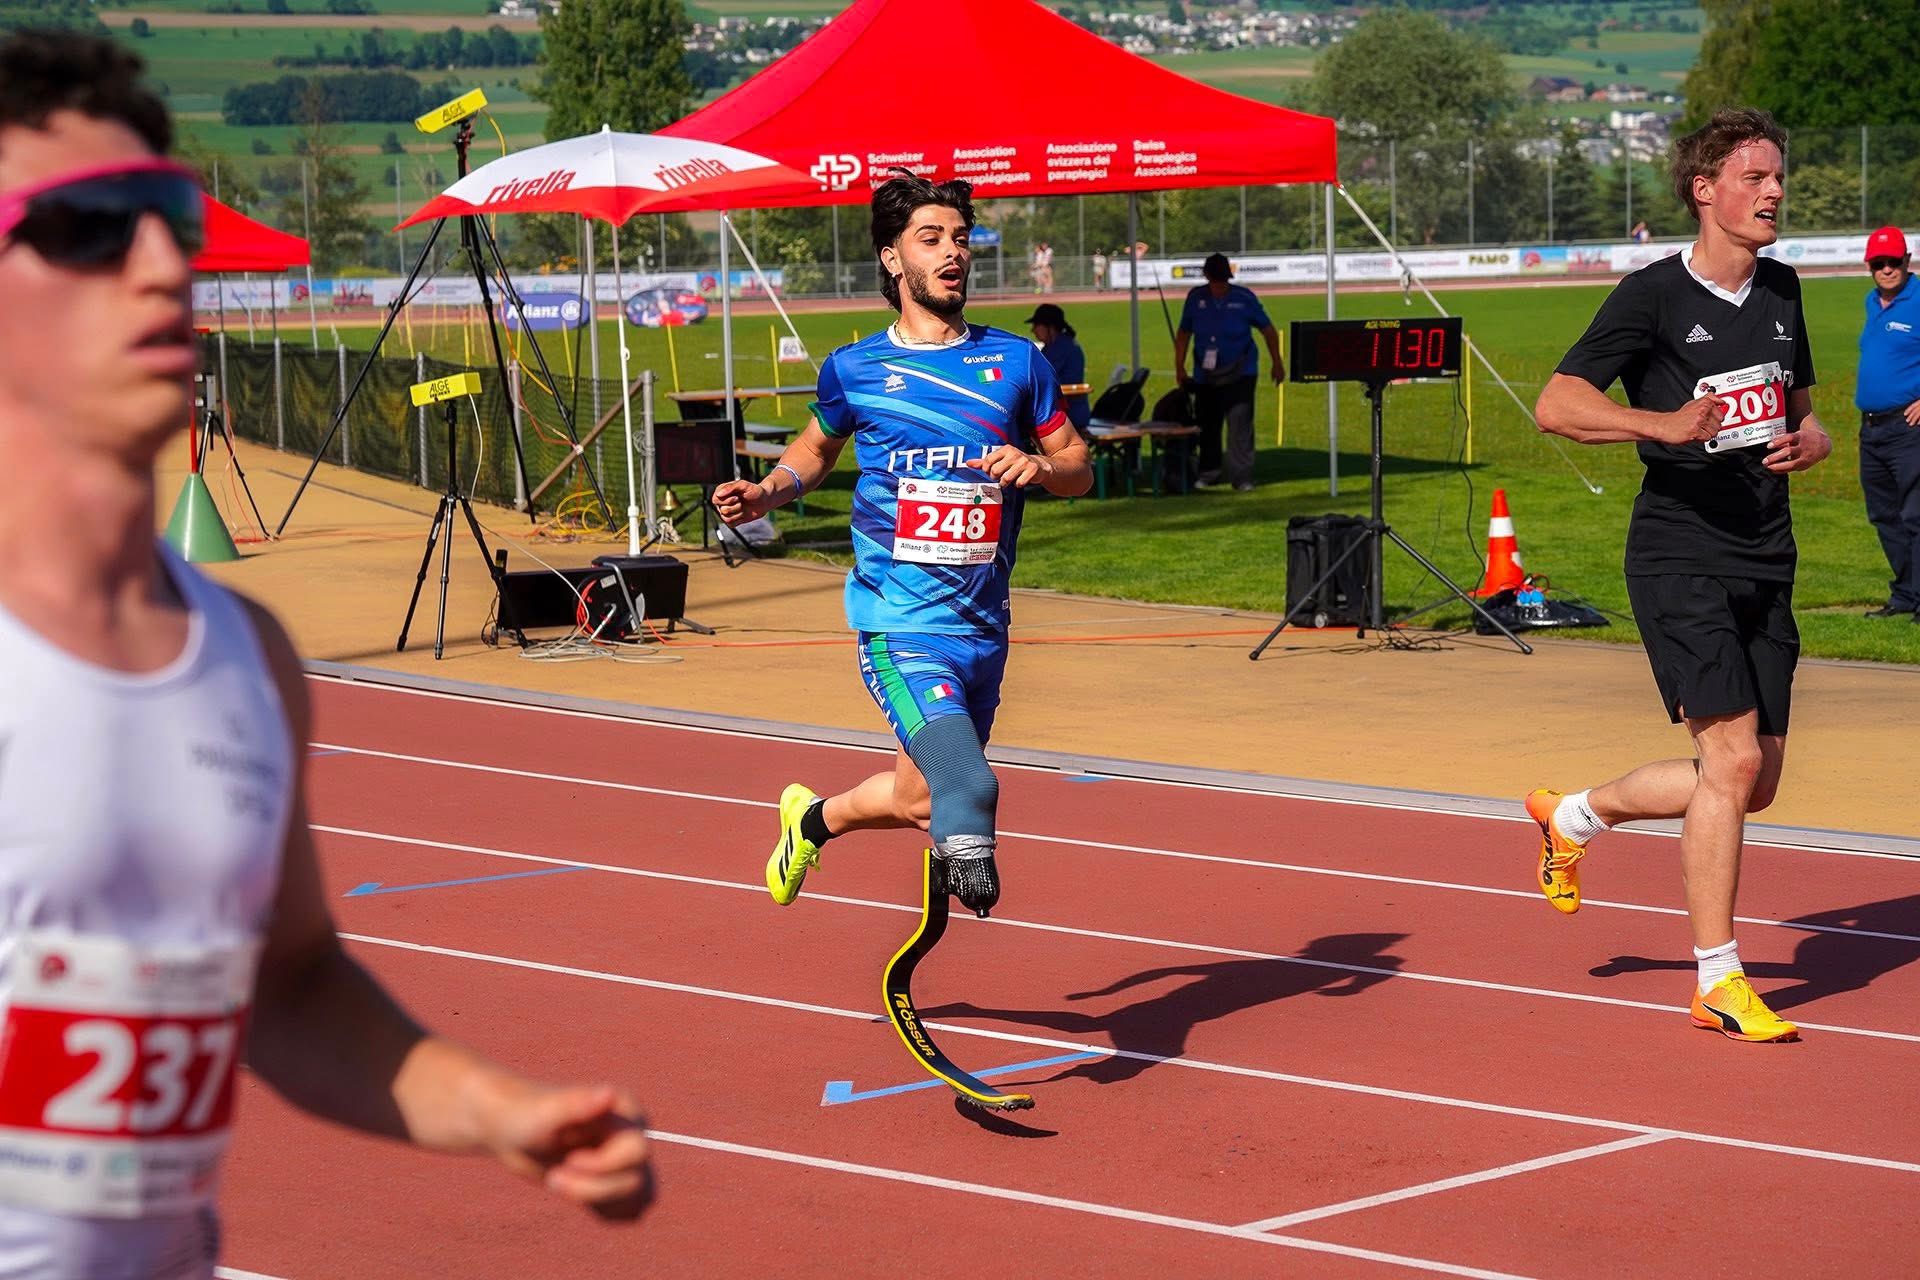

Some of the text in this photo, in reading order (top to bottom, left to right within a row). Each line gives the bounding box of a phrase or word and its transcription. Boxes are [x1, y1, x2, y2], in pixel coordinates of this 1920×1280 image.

[953, 146, 1017, 160] Association
[1046, 141, 1118, 155] Associazione
[1133, 140, 1166, 152] Swiss
[867, 152, 925, 165] Schweizer
[1047, 154, 1111, 168] svizzera dei
[1134, 151, 1197, 165] Paraplegics
[954, 159, 1011, 173] suisse des
[1134, 165, 1197, 178] Association
[654, 157, 730, 190] rivella
[954, 172, 1031, 186] araplégiques
[1047, 168, 1108, 182] paraplegici
[483, 168, 577, 204] rivella
[507, 303, 560, 319] Alianz
[1686, 334, 1713, 343] adidas
[971, 353, 1004, 364] UniCredit
[429, 379, 450, 394] ALGE
[1720, 386, 1778, 427] 209
[914, 505, 986, 540] 248
[900, 542, 921, 551] Allianz
[900, 1011, 936, 1058] ÖSSUR
[42, 1018, 238, 1133] 237
